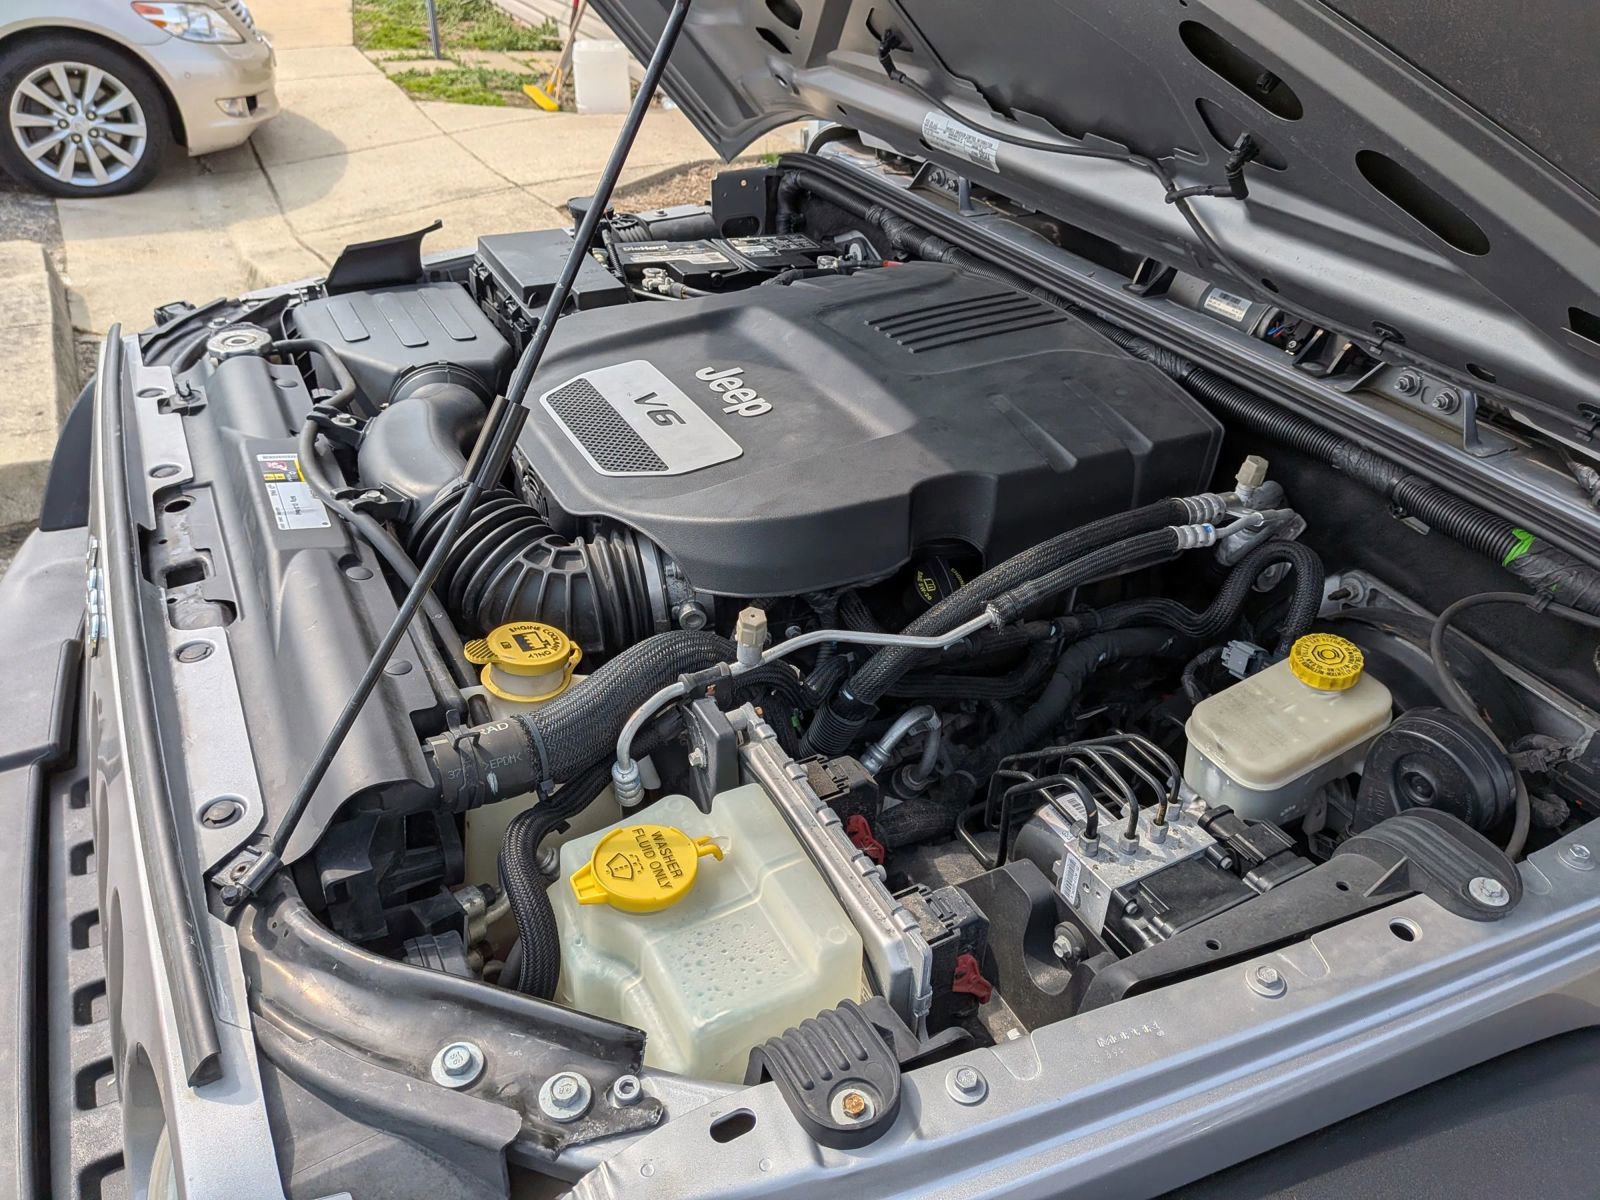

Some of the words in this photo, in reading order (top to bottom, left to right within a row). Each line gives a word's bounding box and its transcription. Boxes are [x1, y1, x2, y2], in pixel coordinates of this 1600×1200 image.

[633, 391, 687, 427] V6
[695, 366, 774, 417] Jeep
[508, 625, 542, 633] ENGINE
[542, 628, 561, 652] COOLANT
[528, 650, 552, 659] ONLY
[632, 827, 656, 859] FLUID
[650, 860, 673, 889] ONLY
[651, 830, 683, 878] WASHER
